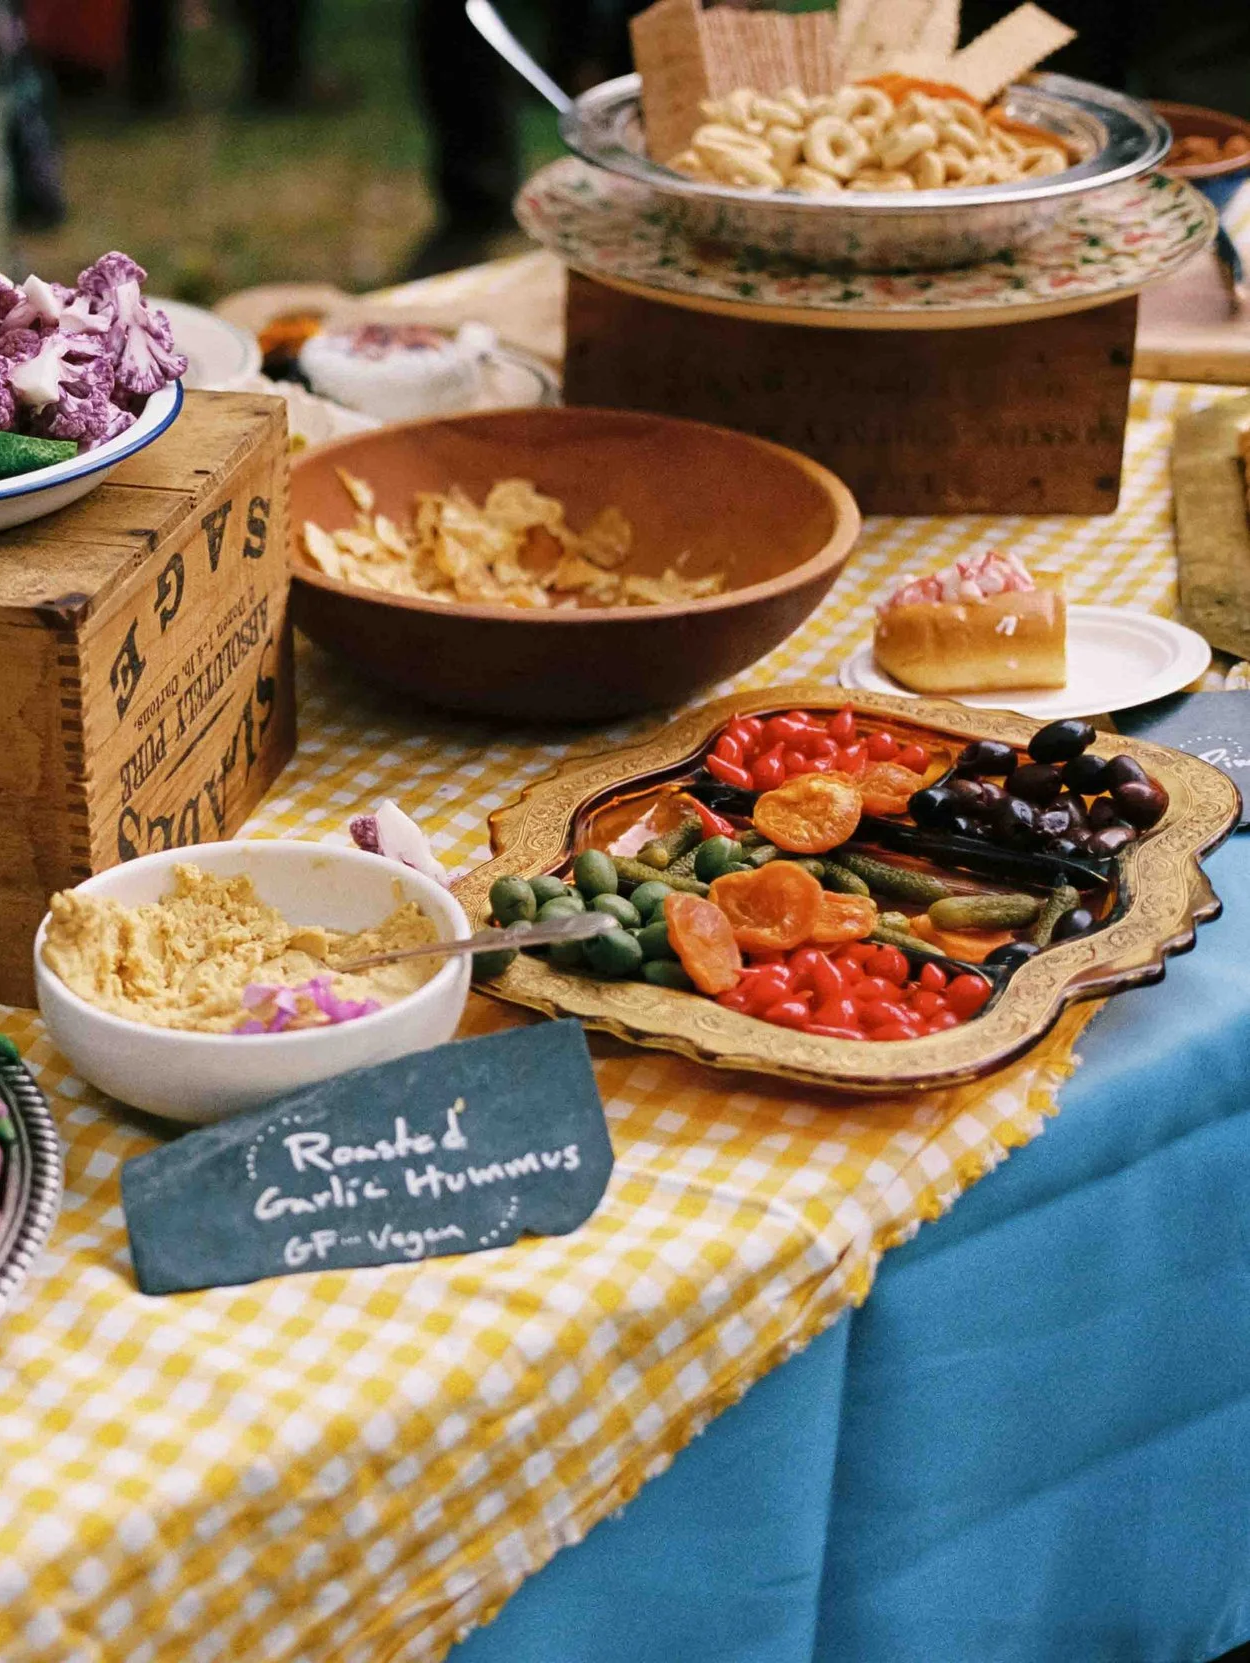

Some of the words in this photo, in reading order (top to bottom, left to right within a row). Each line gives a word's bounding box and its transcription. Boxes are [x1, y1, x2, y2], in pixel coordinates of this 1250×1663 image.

[175, 593, 269, 741] ABSOLUTELY
[119, 723, 166, 806] PURE
[283, 1104, 468, 1173] Roasted
[253, 1180, 390, 1221] Garlic
[405, 1143, 582, 1197] Hummus
